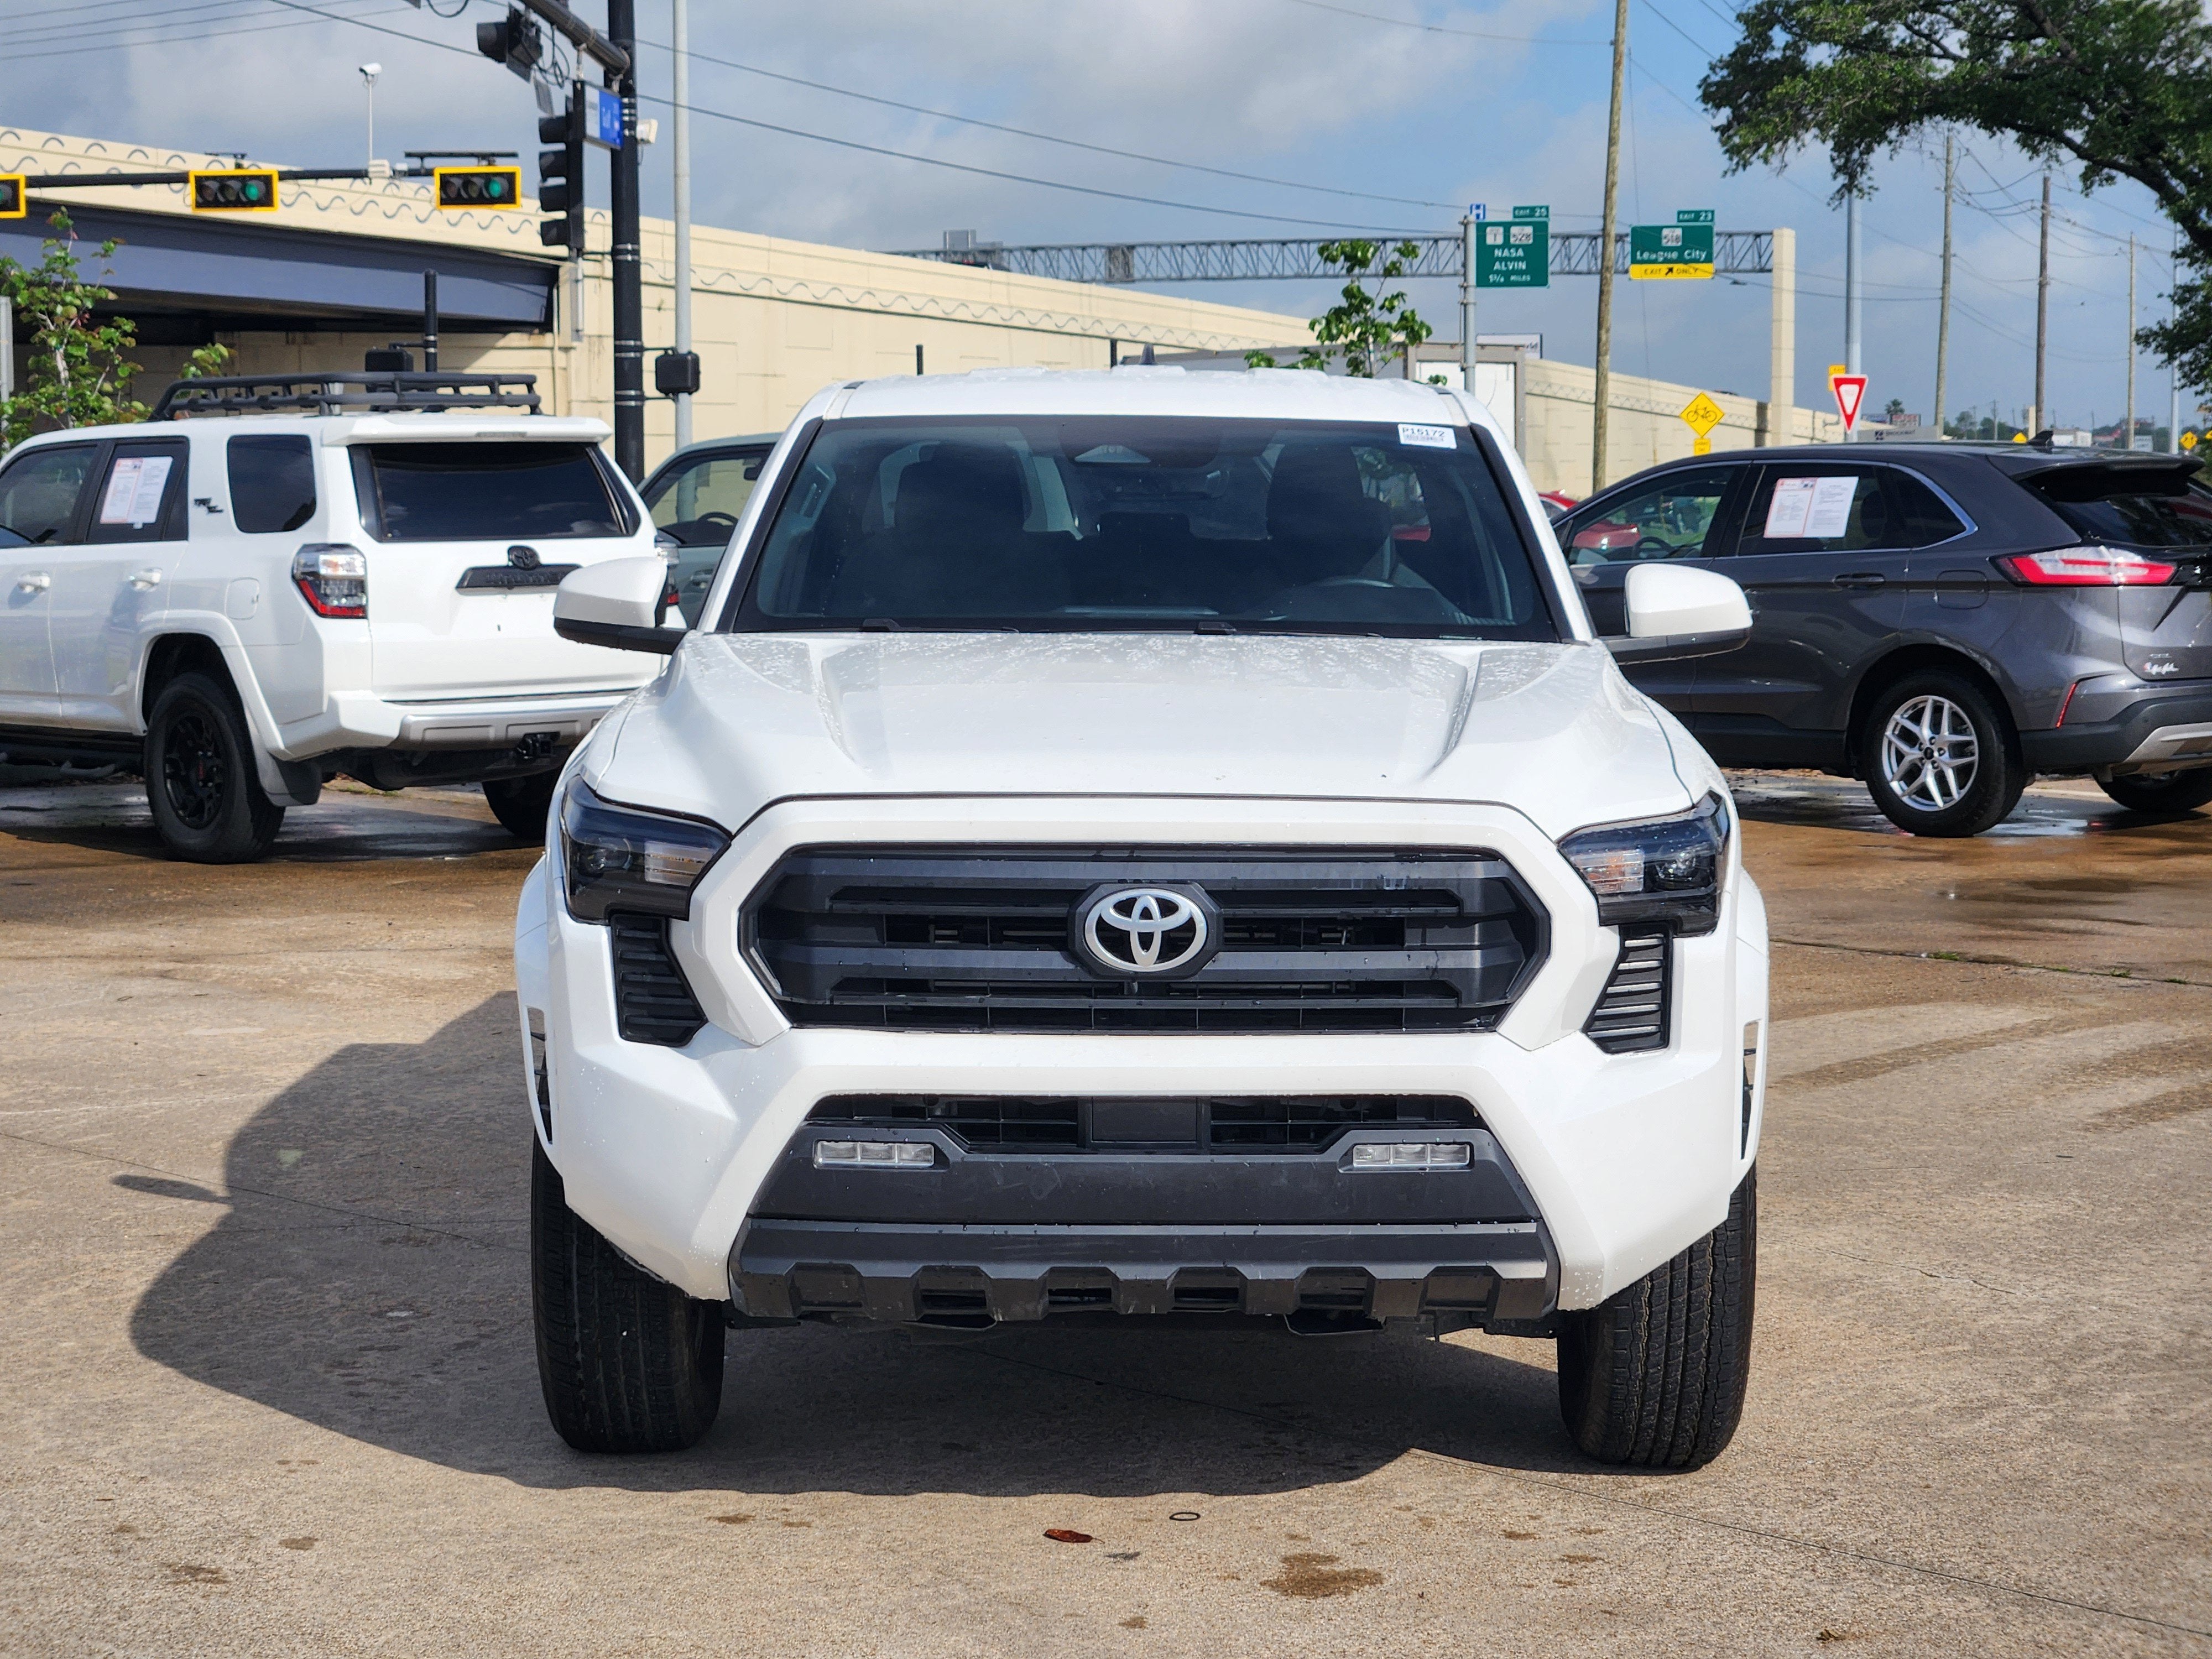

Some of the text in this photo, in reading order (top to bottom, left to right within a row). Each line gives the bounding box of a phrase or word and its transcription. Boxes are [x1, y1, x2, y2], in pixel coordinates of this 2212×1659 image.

[1699, 211, 1712, 221] 23
[1494, 248, 1524, 258] NASA
[1636, 249, 1707, 262] League City
[1493, 260, 1526, 271] ALVIN
